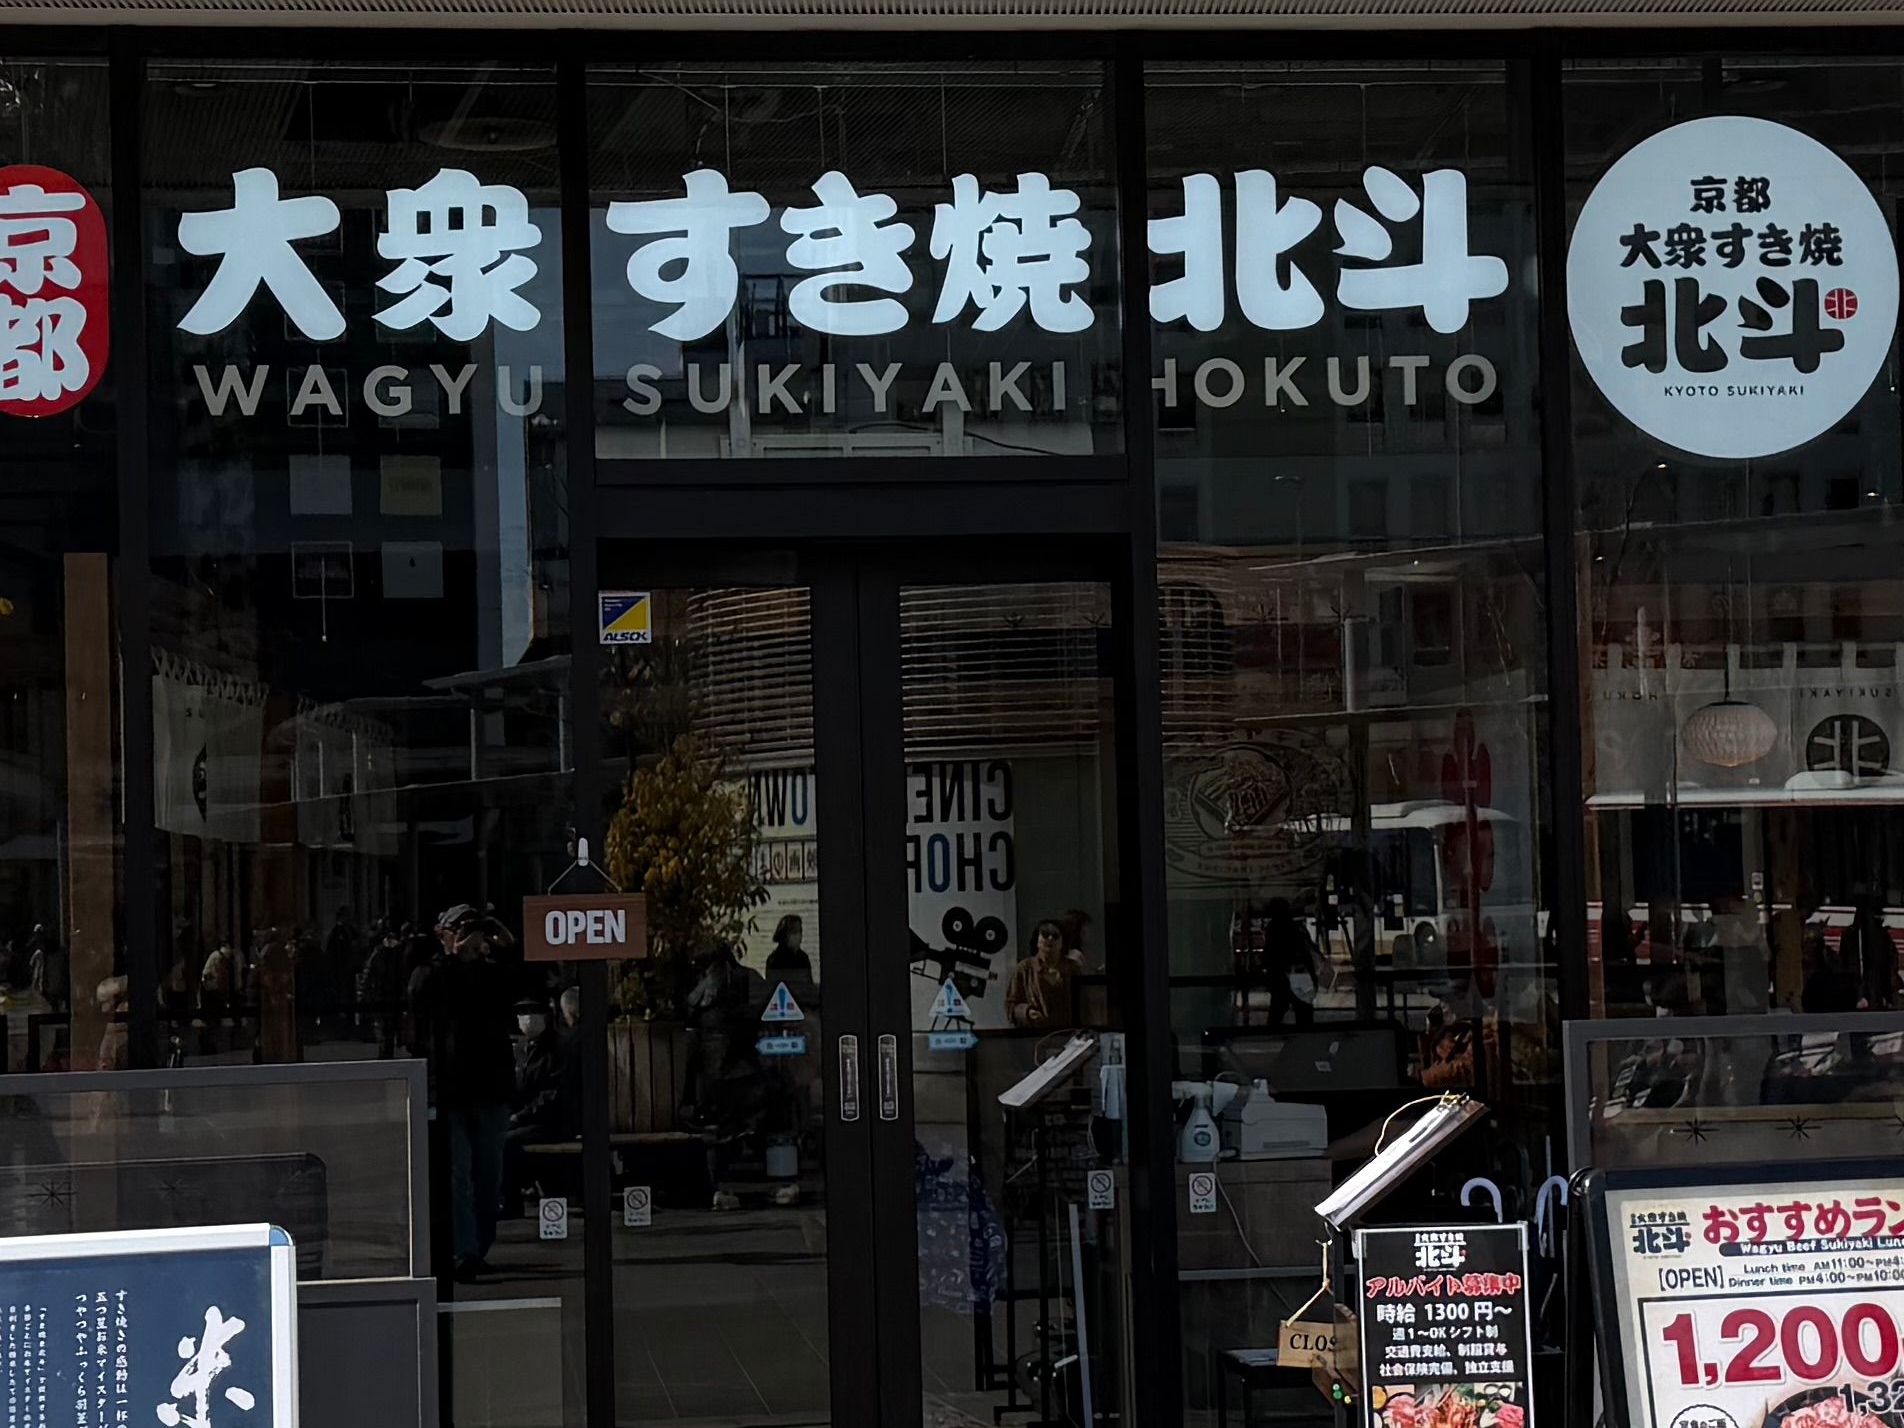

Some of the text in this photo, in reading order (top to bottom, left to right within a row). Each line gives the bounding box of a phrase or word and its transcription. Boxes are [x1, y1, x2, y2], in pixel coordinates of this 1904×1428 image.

[1690, 176, 1771, 213] 京都
[178, 165, 1510, 341] 大衆 すき焼 北斗
[1619, 222, 1844, 269] 大衆すき焼
[1620, 276, 1846, 374] 北斗
[193, 352, 1499, 417] WAGYU SUKIYAKI HOKUTO
[1664, 385, 1805, 397] KYOTO SUKIYAKI
[545, 909, 626, 945] OPEN
[1632, 1227, 1692, 1255] 北斗
[1820, 1236, 1873, 1252] Sukiyaki
[1415, 1245, 1466, 1268] 北斗
[1744, 1262, 1780, 1274] Lunch
[1366, 1272, 1522, 1299] アルバイト募集中
[1376, 1303, 1470, 1324] 時給 1300
